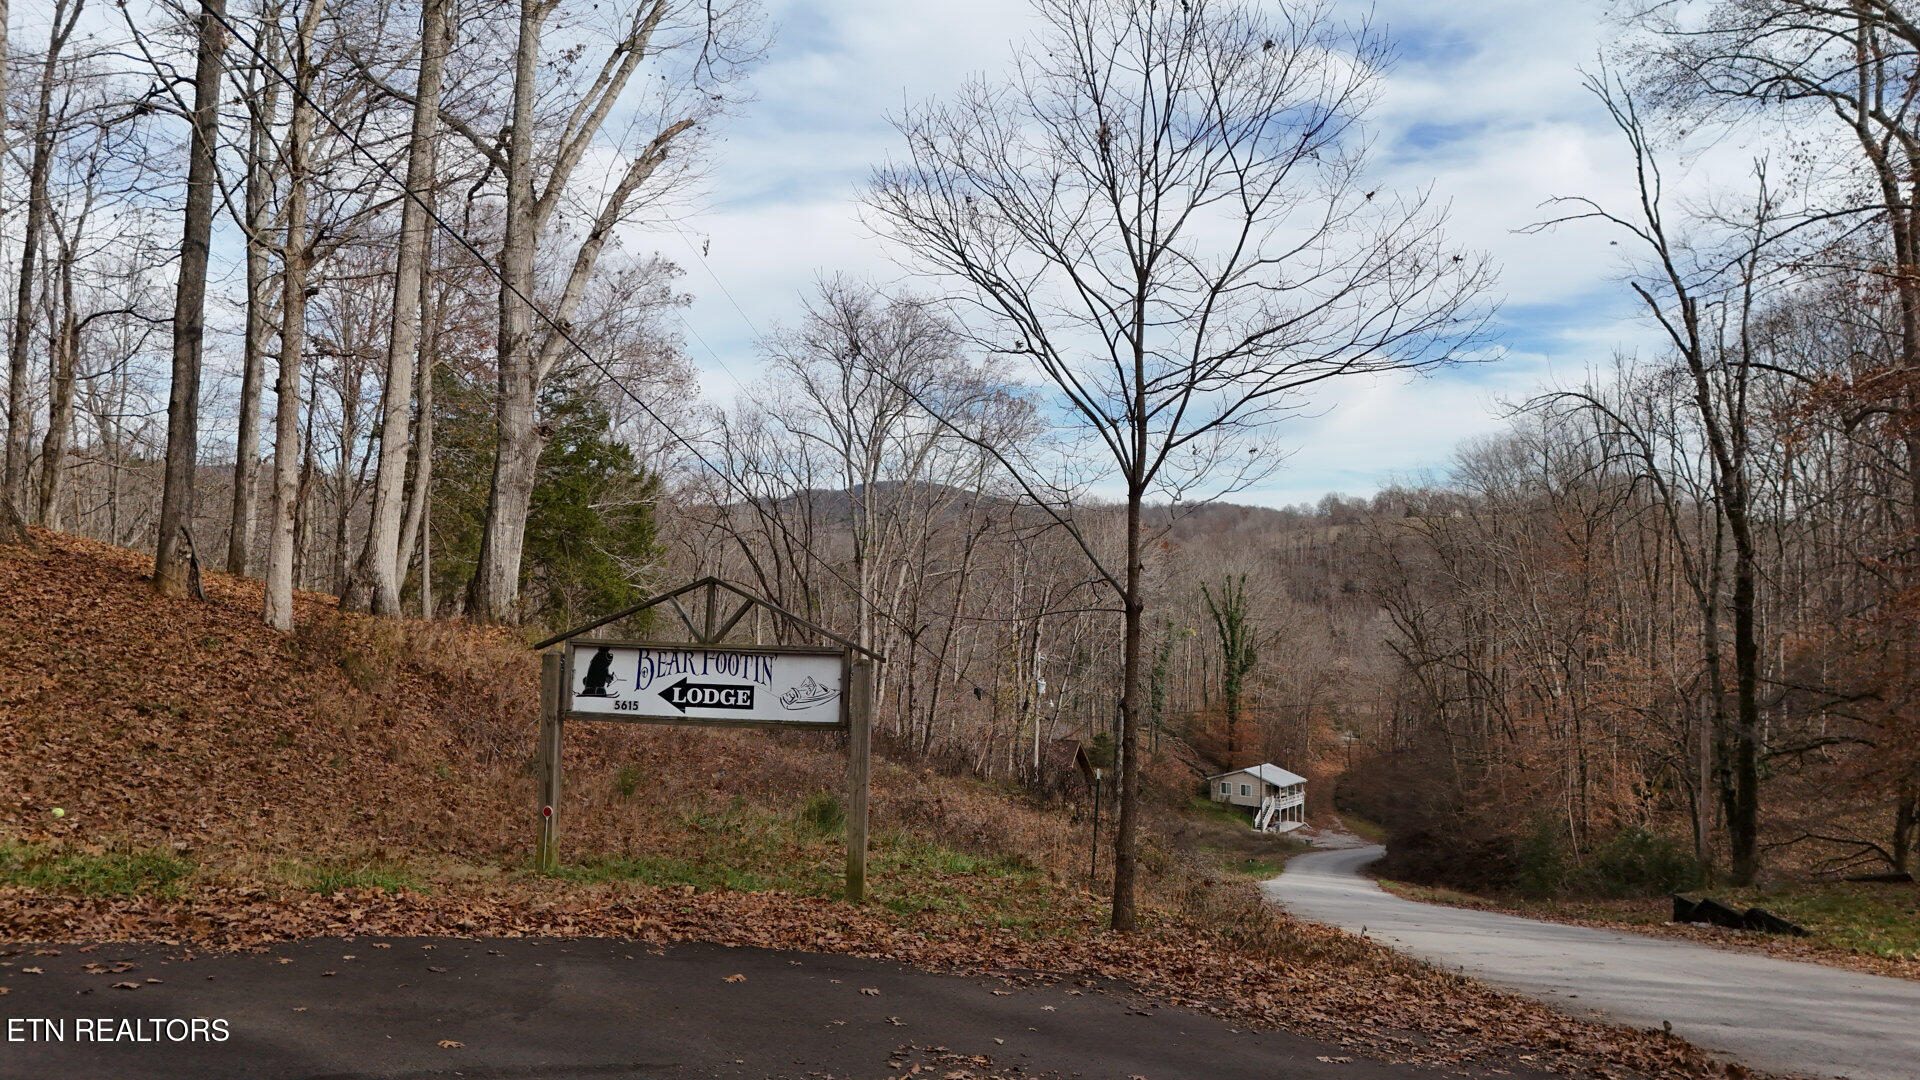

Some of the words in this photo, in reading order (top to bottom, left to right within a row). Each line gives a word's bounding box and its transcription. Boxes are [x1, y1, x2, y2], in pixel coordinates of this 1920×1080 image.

[634, 648, 699, 692] BEAR
[613, 700, 639, 711] 5615
[672, 687, 751, 706] LODGE
